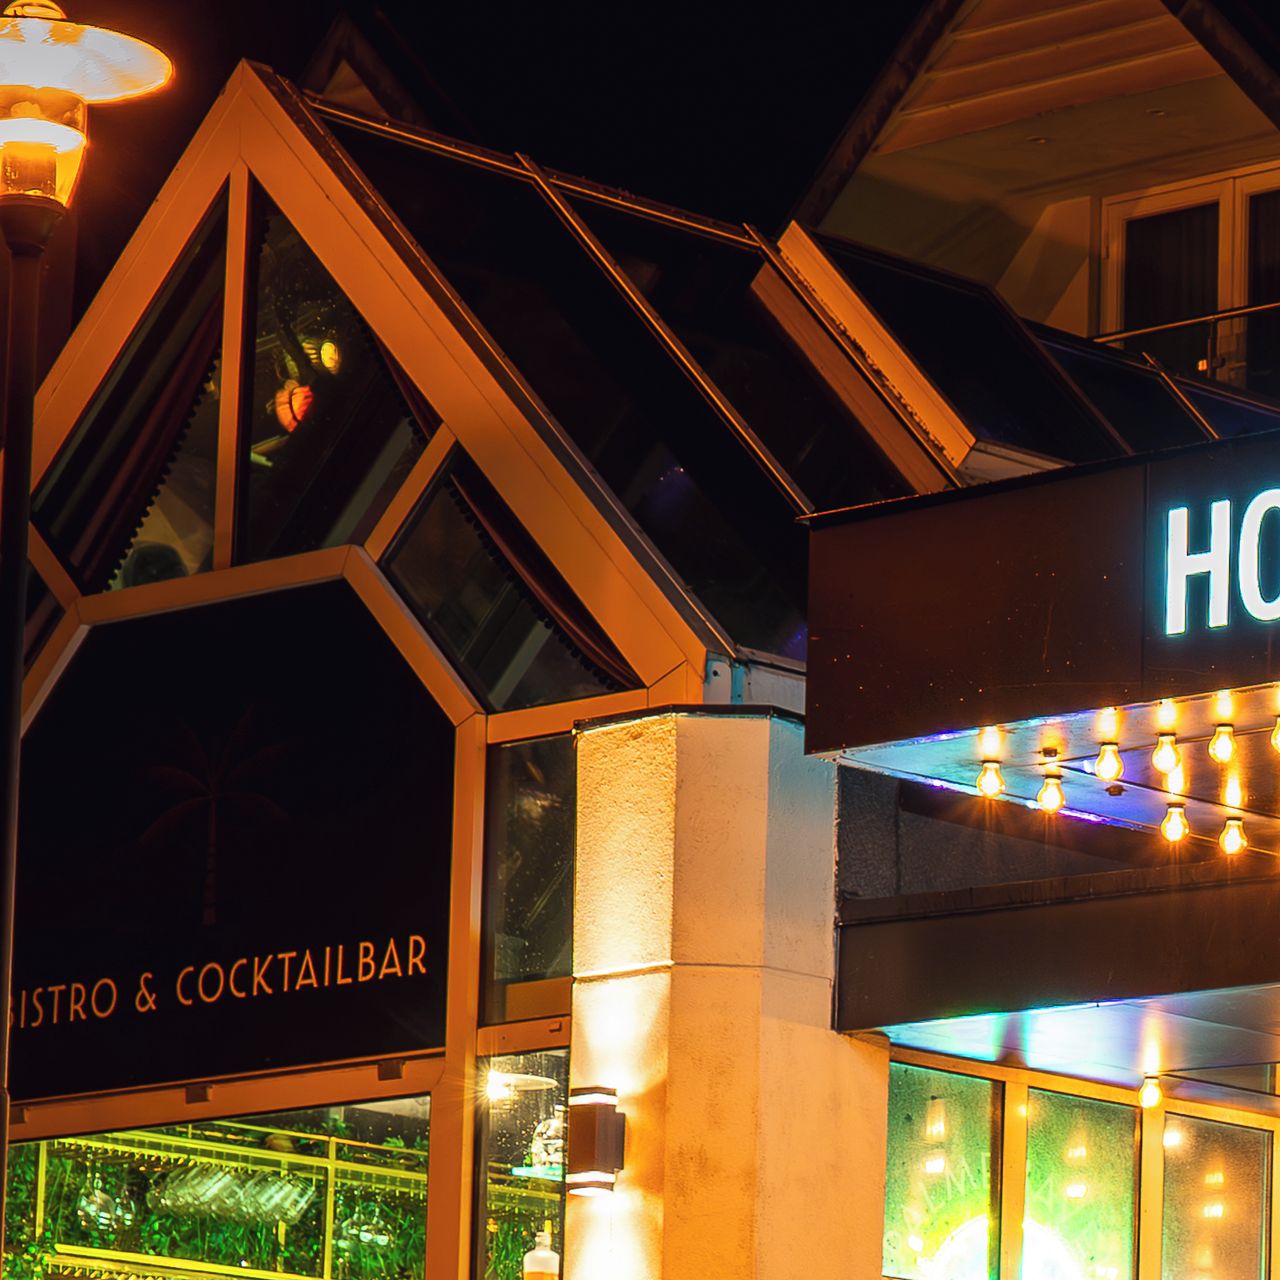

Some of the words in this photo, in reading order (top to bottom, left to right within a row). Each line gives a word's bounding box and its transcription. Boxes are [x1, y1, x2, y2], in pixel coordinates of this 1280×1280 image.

[10, 977, 118, 1029] ISTRO
[135, 972, 157, 1013] &
[176, 934, 428, 1006] COCKTAILBAR
